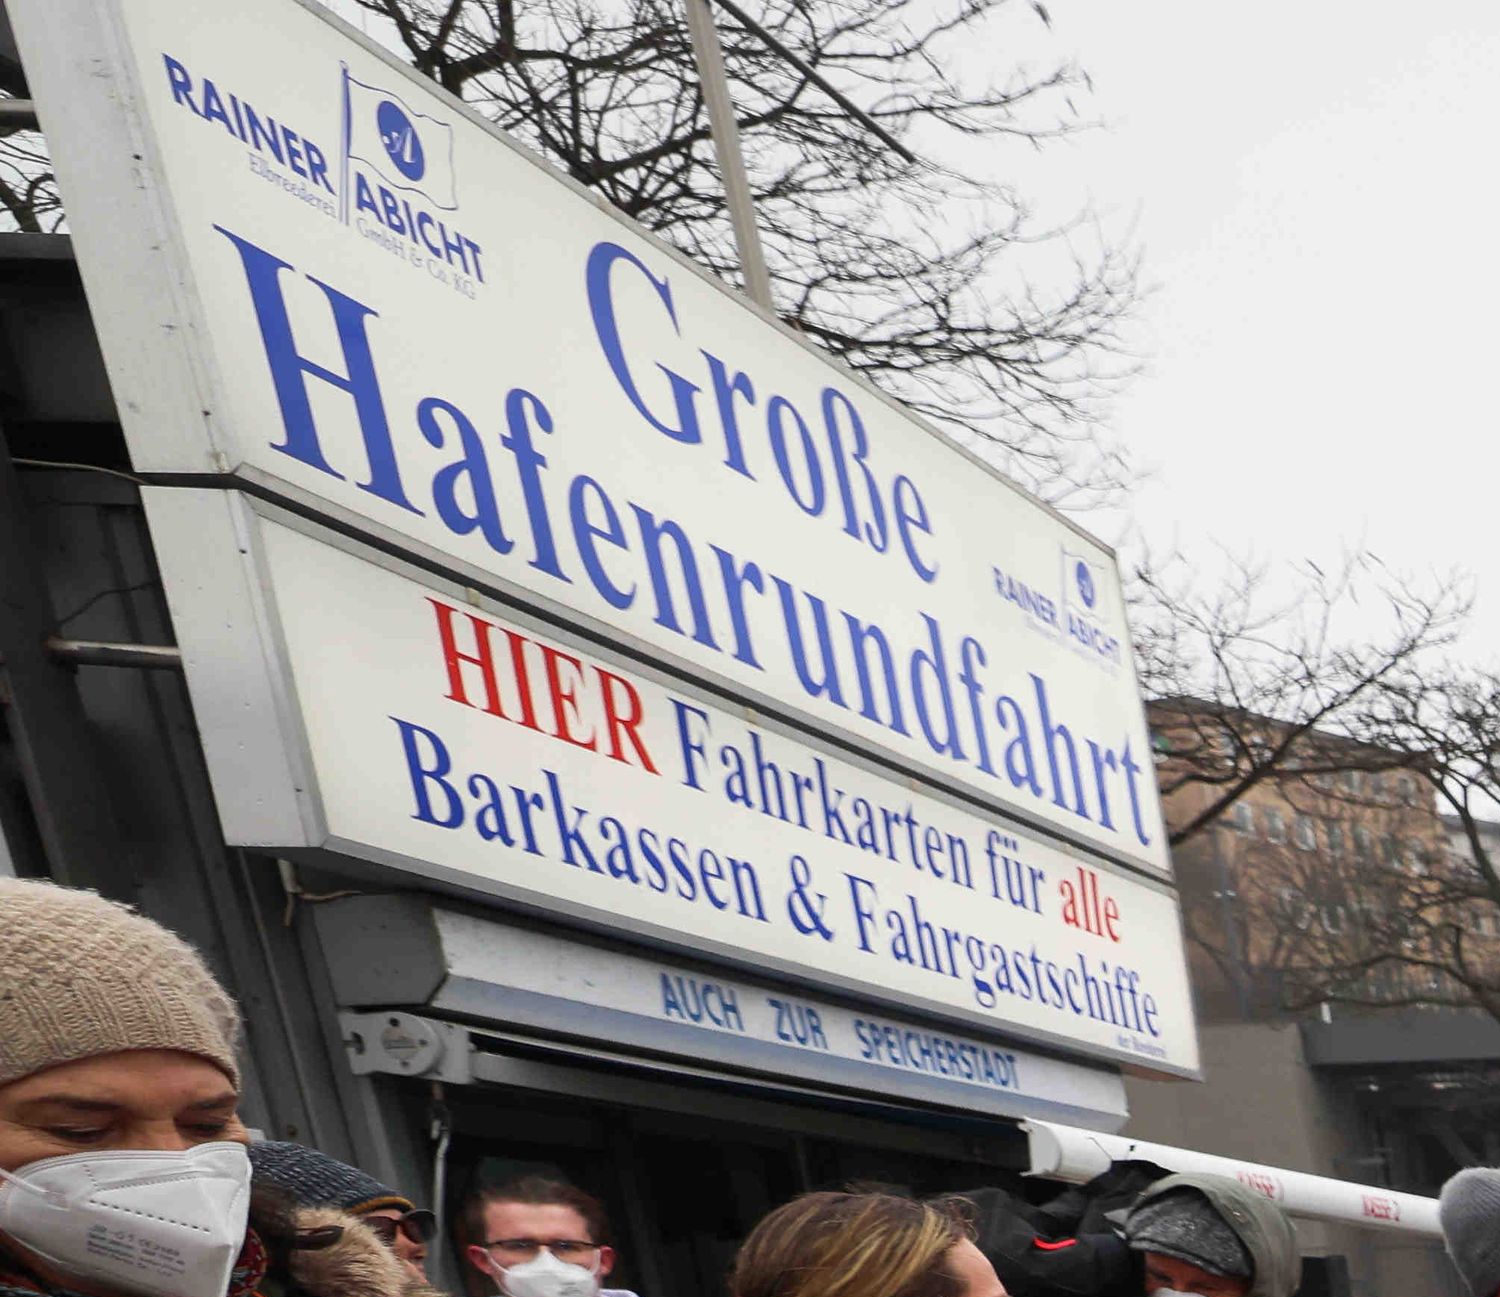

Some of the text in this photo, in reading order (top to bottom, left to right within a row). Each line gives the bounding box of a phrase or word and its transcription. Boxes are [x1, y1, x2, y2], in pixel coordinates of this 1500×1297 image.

[162, 53, 338, 197] RAINER
[355, 172, 486, 284] ABICHT
[212, 223, 1152, 847] Hafenrundfahrt
[585, 242, 938, 583] Große
[390, 714, 1160, 1038] Barkassen & Fahrgastschiffe
[425, 597, 1122, 944] HIER Fahrkarten für alle
[659, 972, 1022, 1091] AUCH ZUR SPEICHERSTADT
